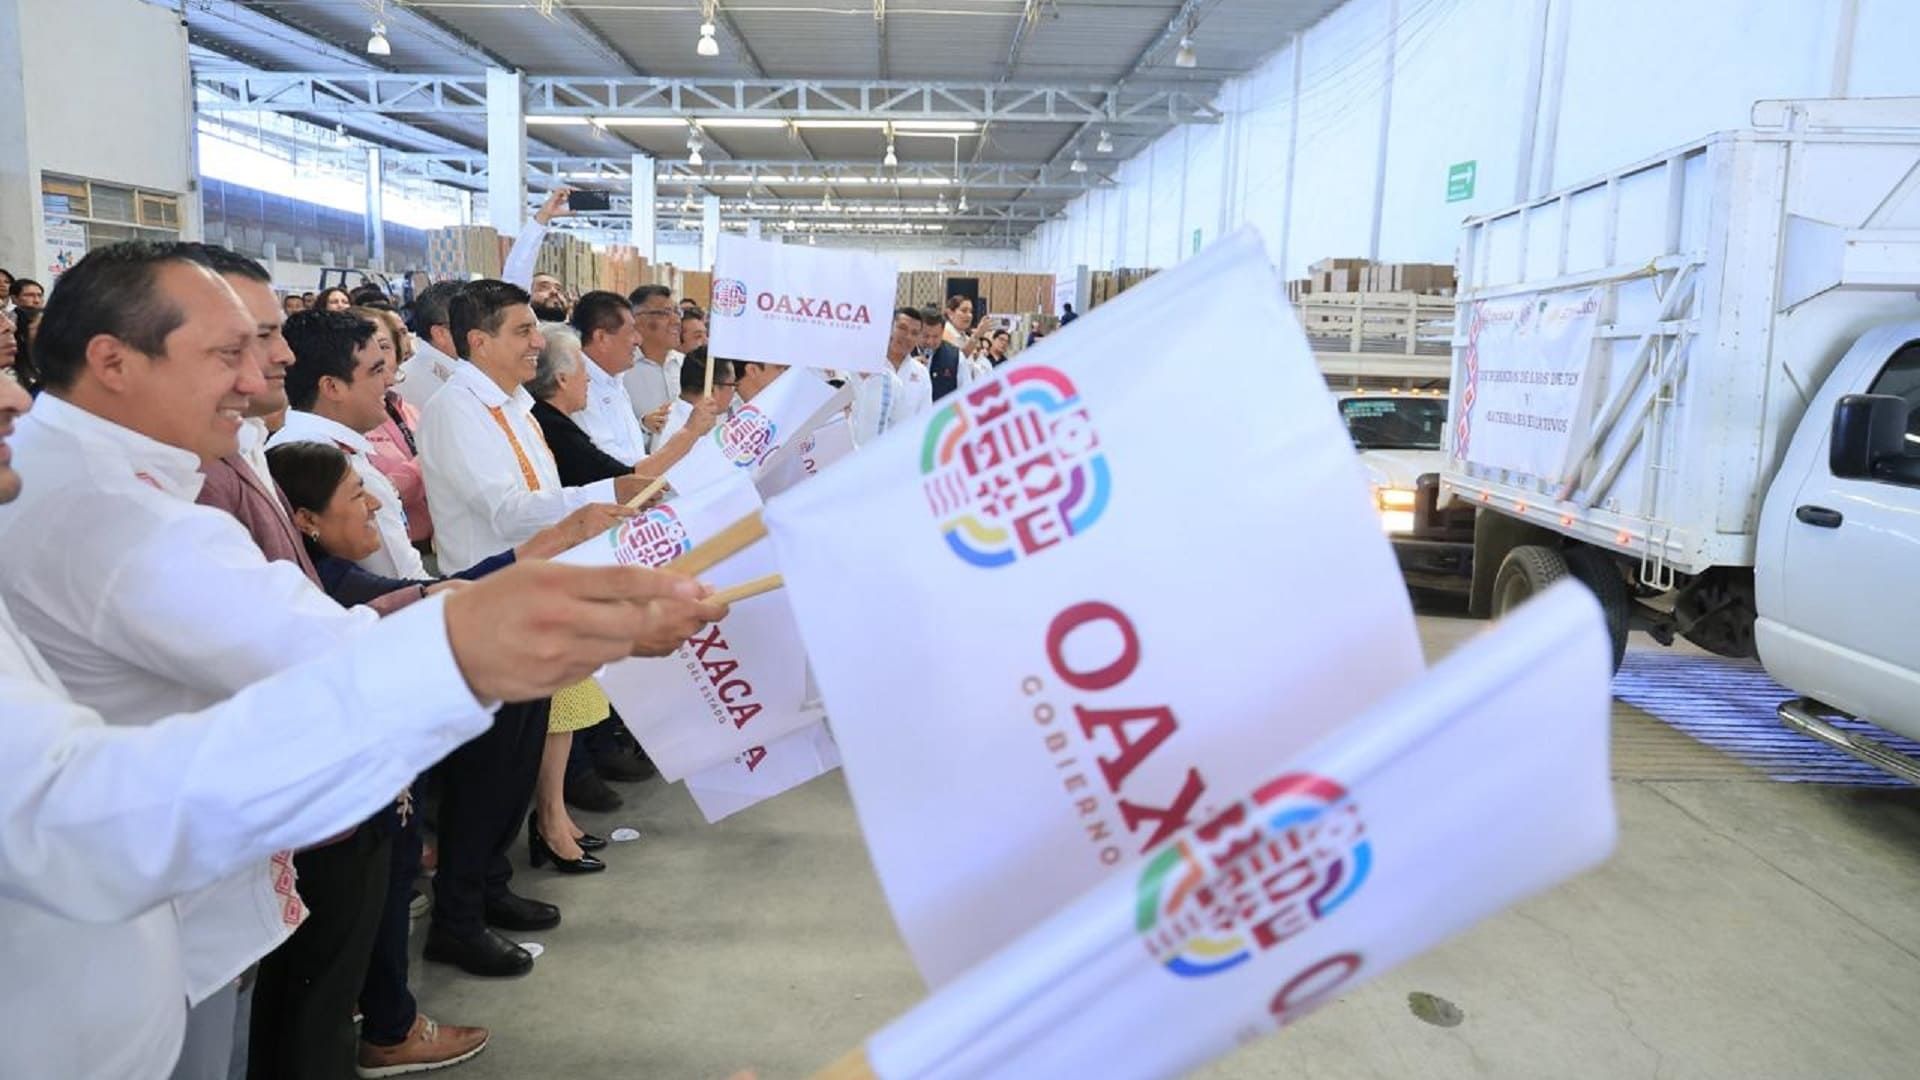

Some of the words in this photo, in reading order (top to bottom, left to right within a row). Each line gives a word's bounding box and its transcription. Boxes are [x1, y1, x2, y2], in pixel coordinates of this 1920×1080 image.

[757, 292, 871, 324] OAXACA
[686, 662, 702, 683] DEL
[700, 685, 727, 725] ESTADO
[688, 624, 763, 730] XACA
[1045, 601, 1206, 854] OAX
[1021, 675, 1122, 865] GOBIERNO
